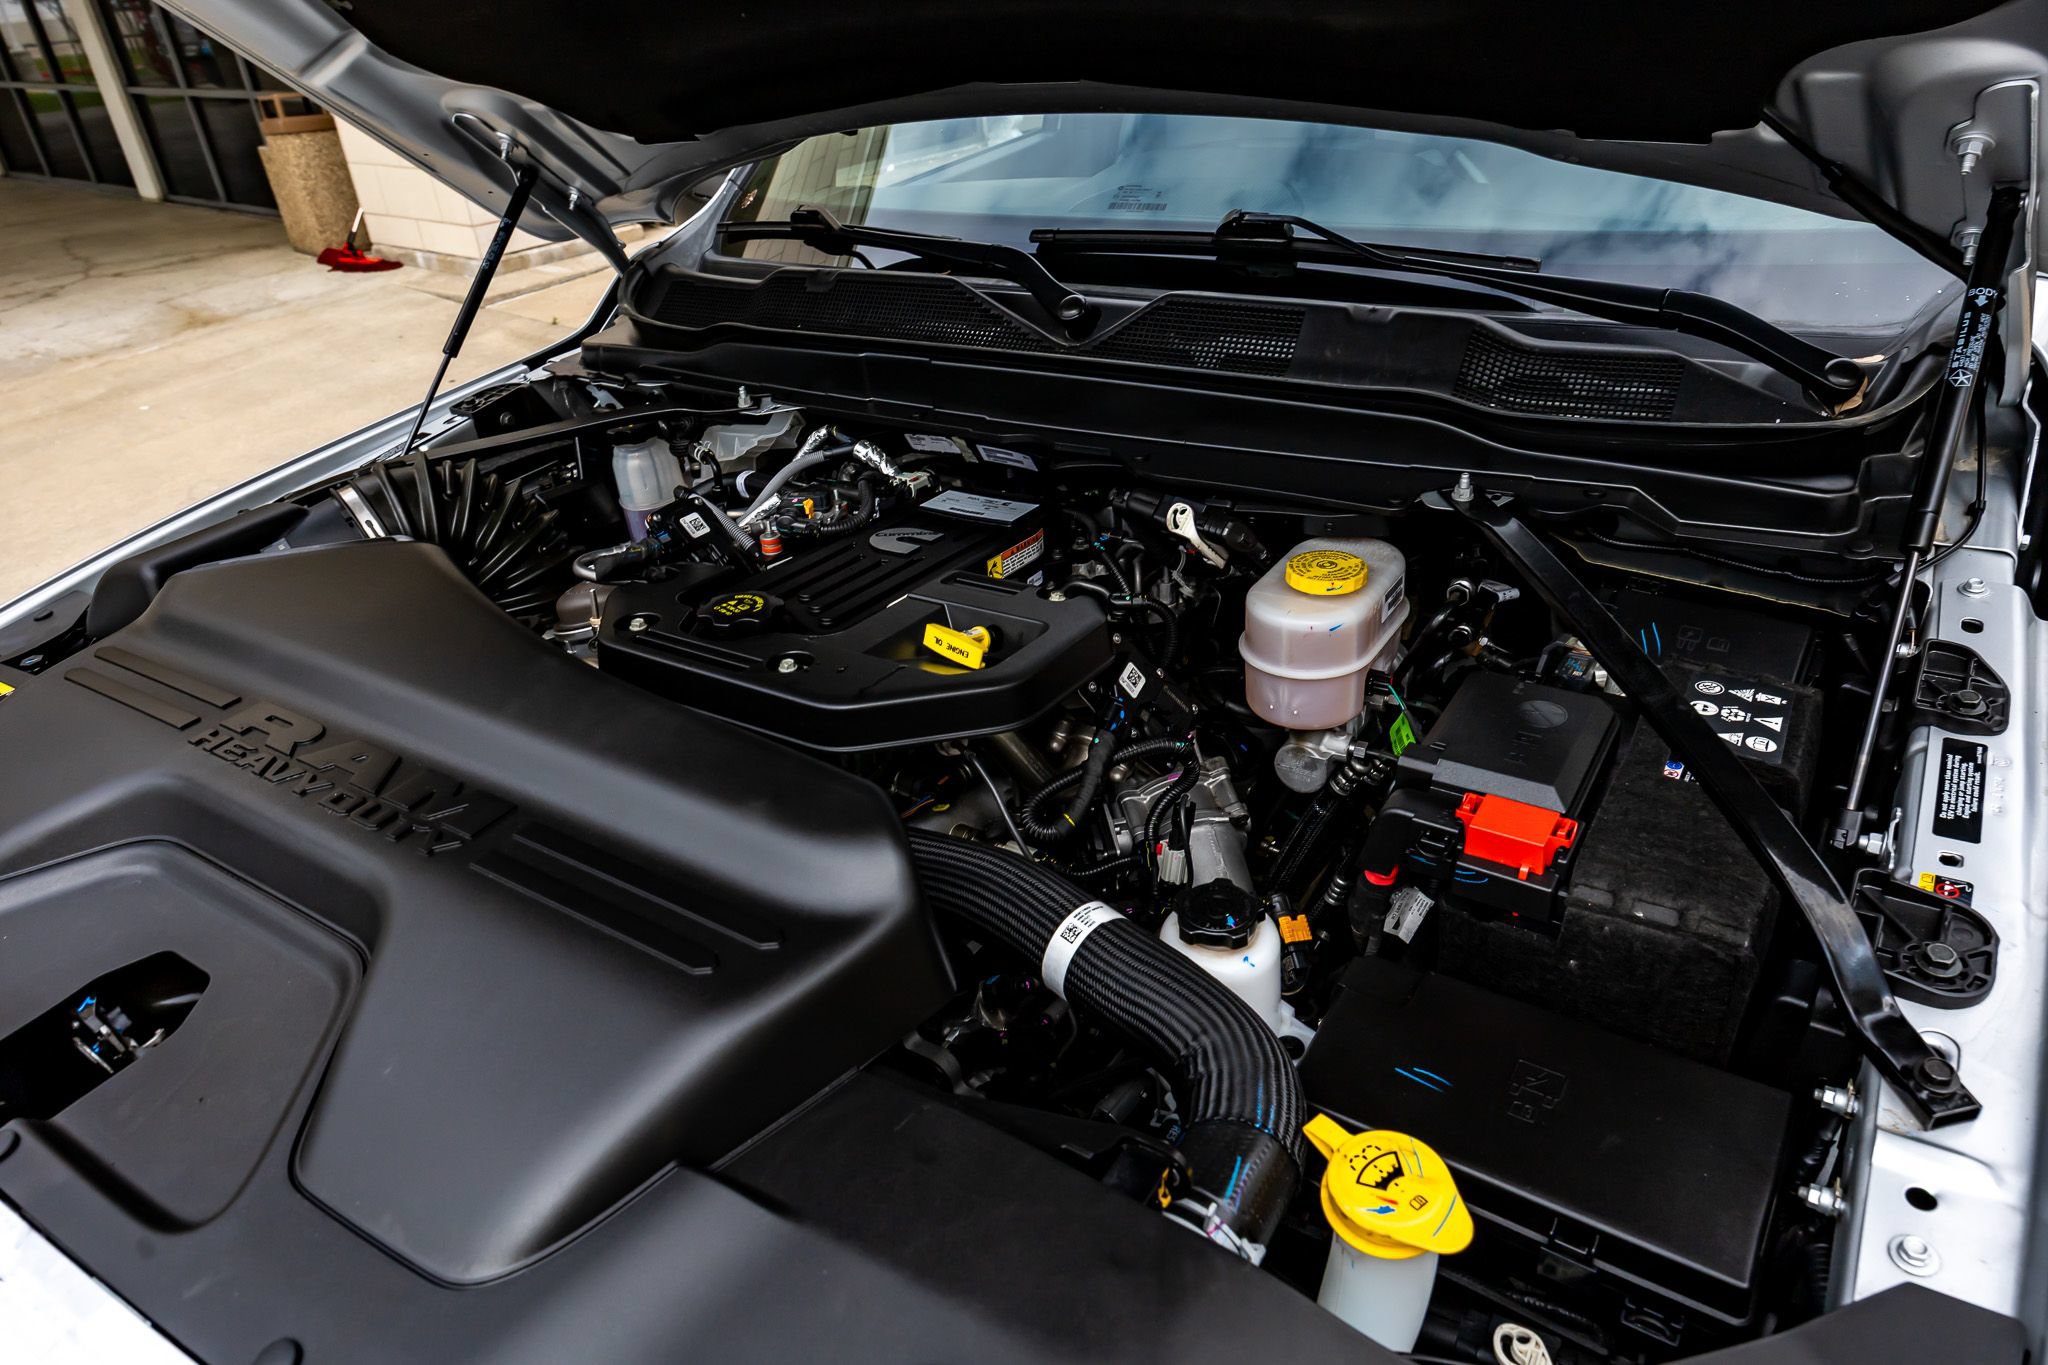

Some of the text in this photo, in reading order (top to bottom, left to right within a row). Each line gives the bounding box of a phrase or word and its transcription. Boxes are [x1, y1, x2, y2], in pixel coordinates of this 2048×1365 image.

[1968, 287, 1998, 299] BODY
[1952, 311, 1972, 368] STABILUS
[933, 636, 969, 658] ENGINE OIL
[1953, 755, 1962, 768] during
[220, 702, 518, 840] RAM
[188, 728, 464, 857] HEAVY DUTY
[1966, 778, 1974, 794] starting
[1942, 791, 1950, 802] apply
[1955, 797, 1964, 816] charging
[1962, 804, 1971, 818] Engine
